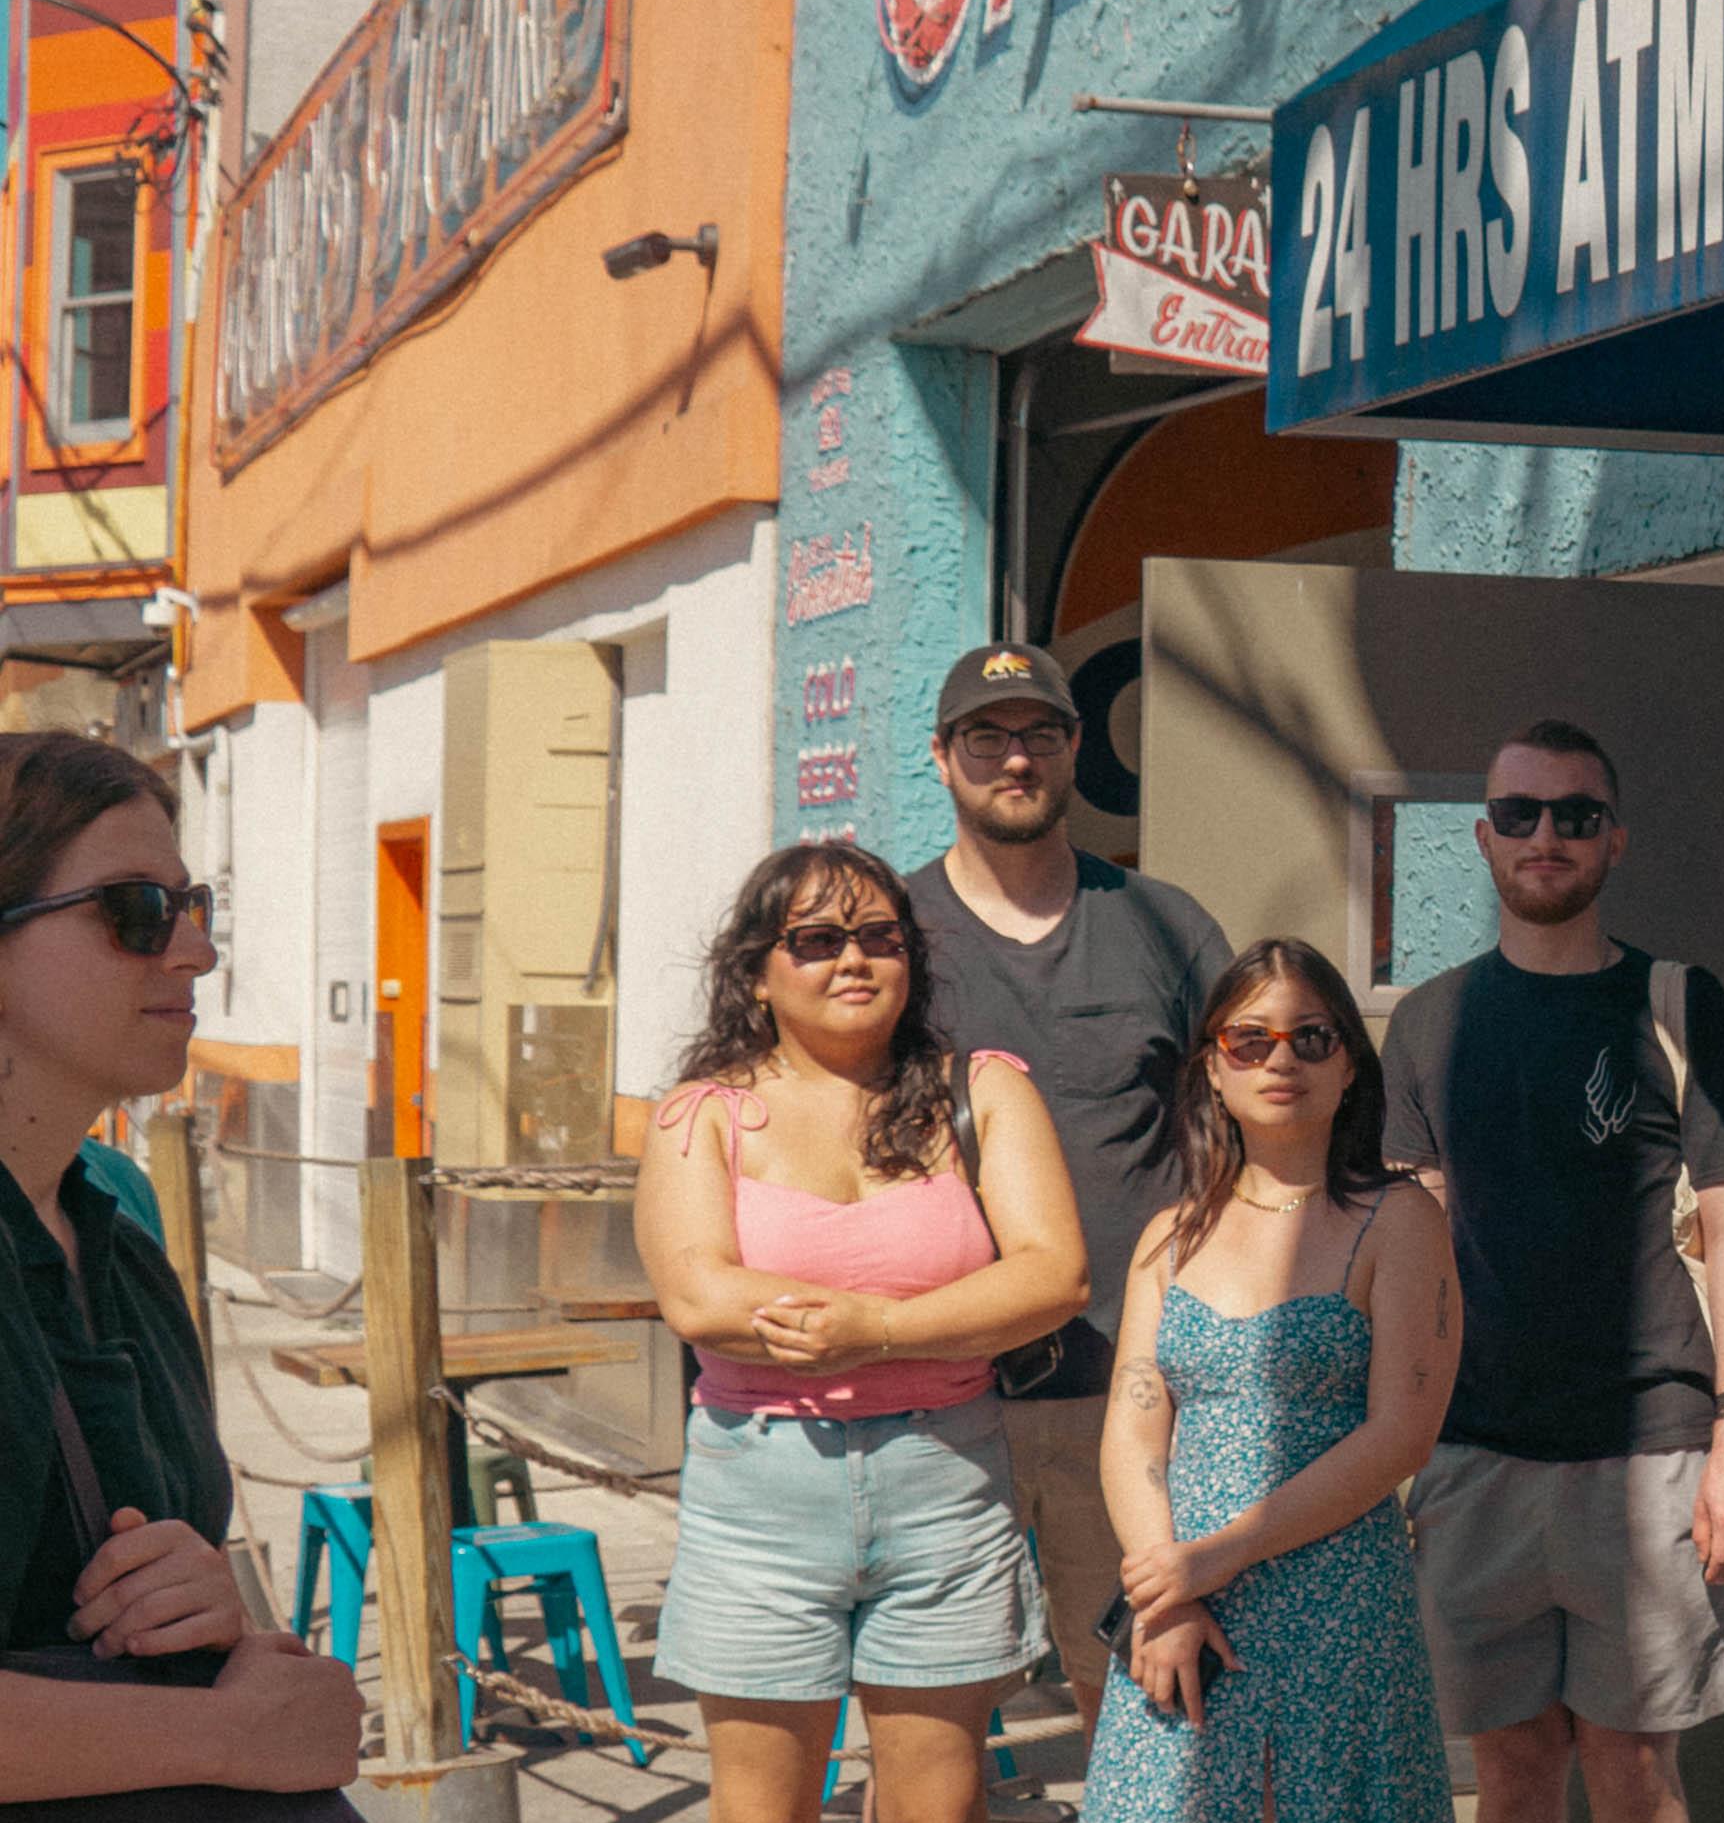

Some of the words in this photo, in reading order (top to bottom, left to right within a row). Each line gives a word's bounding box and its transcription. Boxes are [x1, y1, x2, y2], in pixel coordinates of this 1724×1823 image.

[1116, 196, 1270, 299] GARA
[1298, 106, 1371, 378] 24
[1397, 23, 1533, 345] HRS
[1152, 292, 1269, 363] Entra
